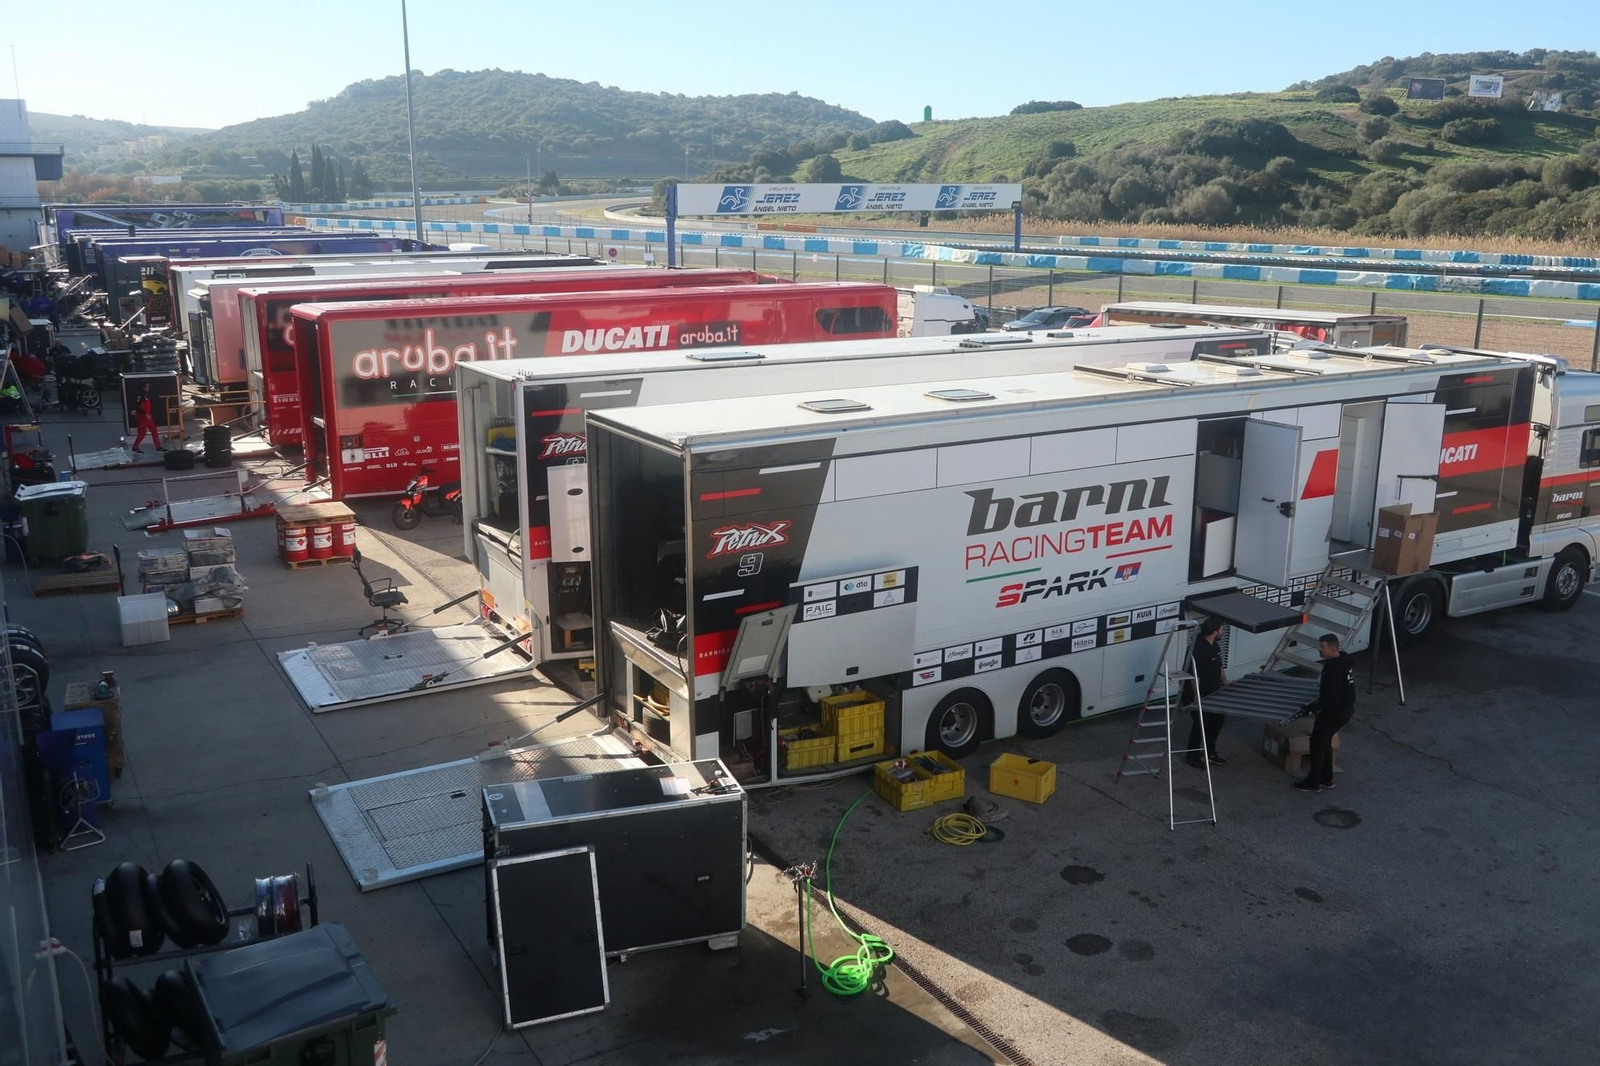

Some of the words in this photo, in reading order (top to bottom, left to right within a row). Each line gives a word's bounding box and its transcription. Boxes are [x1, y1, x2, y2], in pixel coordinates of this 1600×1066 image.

[756, 193, 801, 204] JEREZ
[868, 192, 906, 202] JEREZ
[963, 192, 997, 201] JEREZ
[561, 325, 671, 353] DUCATI
[680, 324, 739, 345] aruba.it
[353, 326, 517, 379] arubait
[963, 475, 1174, 537] barni
[1552, 491, 1584, 503] barni
[965, 514, 1173, 570] RACINGTEAM
[737, 552, 764, 577] 9
[995, 566, 1113, 608] SPARK
